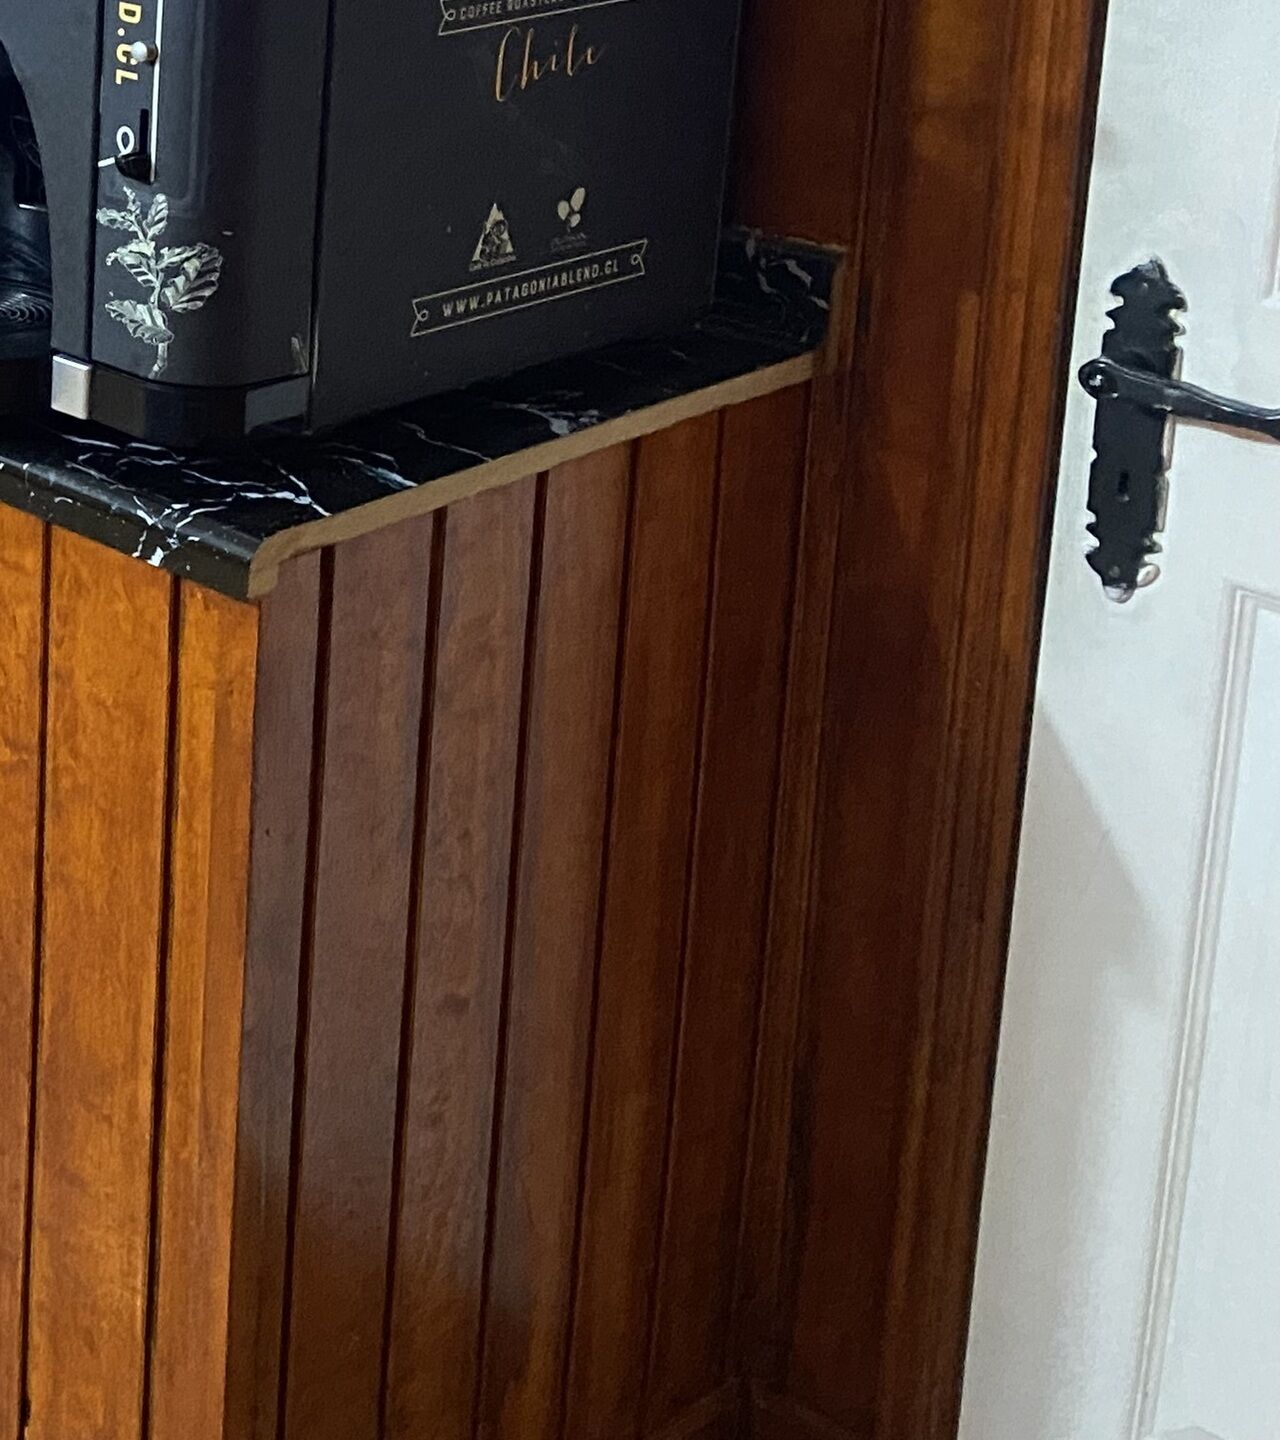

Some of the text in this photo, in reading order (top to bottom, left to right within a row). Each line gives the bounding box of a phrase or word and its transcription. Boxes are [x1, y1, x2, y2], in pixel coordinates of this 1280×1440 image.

[459, 0, 503, 21] COFFEE
[495, 23, 607, 102] Chile
[441, 258, 620, 318] WWW.PATAGONIABLEND.CL
